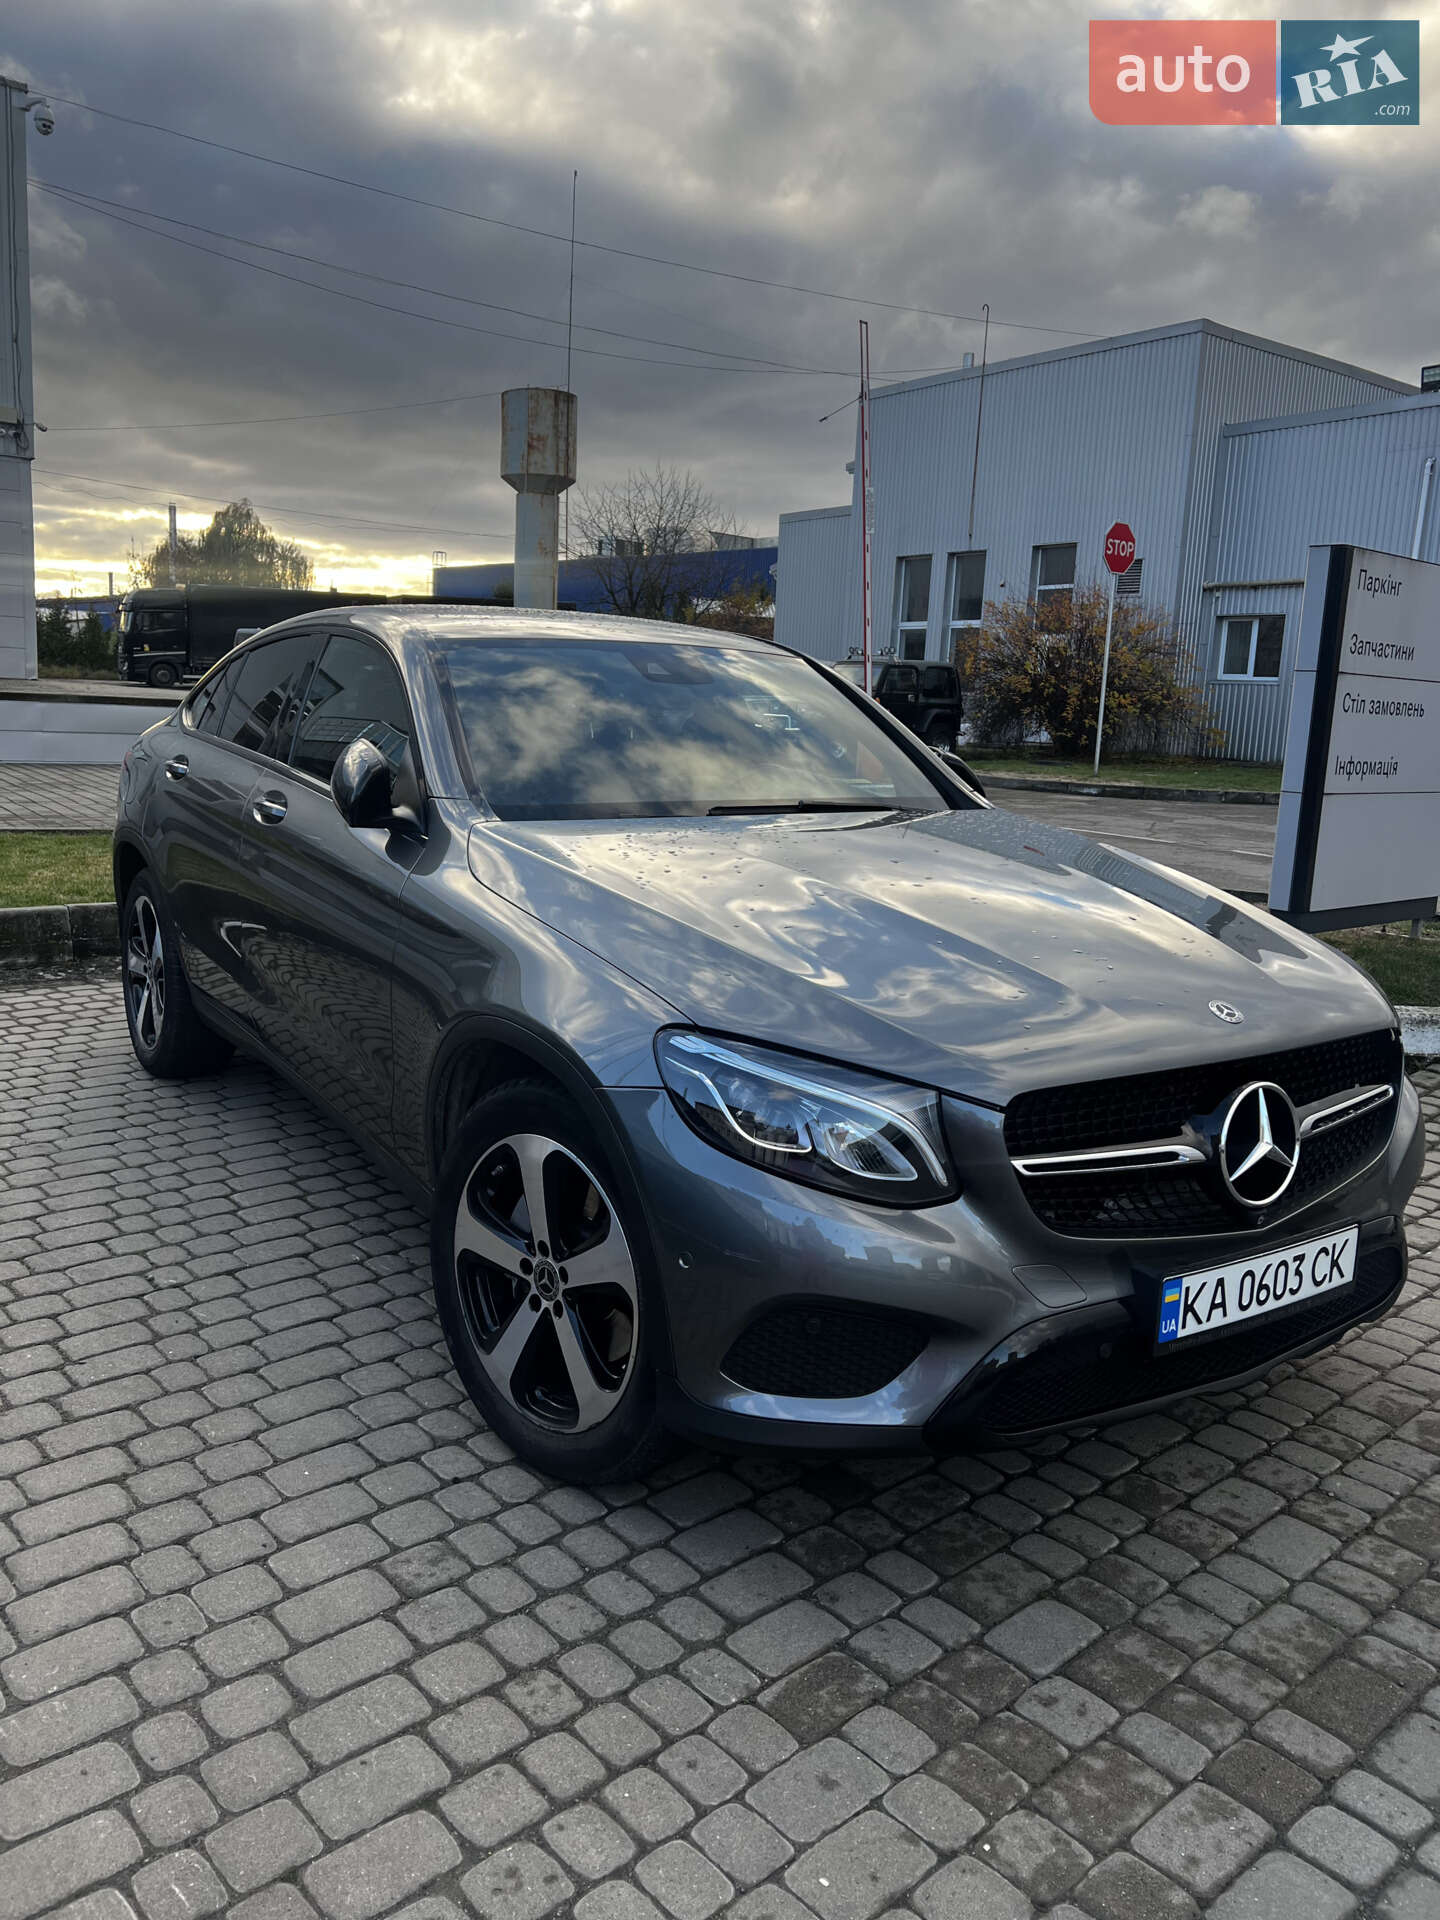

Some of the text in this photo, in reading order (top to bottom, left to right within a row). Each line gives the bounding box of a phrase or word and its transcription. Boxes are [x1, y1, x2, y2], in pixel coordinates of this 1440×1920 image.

[1106, 538, 1134, 557] STOP
[1358, 568, 1402, 598] Паркінг
[1350, 633, 1415, 661] Запчастини
[1342, 692, 1425, 718] Стіл замовлень
[1334, 755, 1398, 781] Інформація
[1181, 1276, 1228, 1330] KA
[1238, 1253, 1306, 1312] 0603
[1311, 1238, 1349, 1288] CK
[1162, 1318, 1176, 1334] UA
